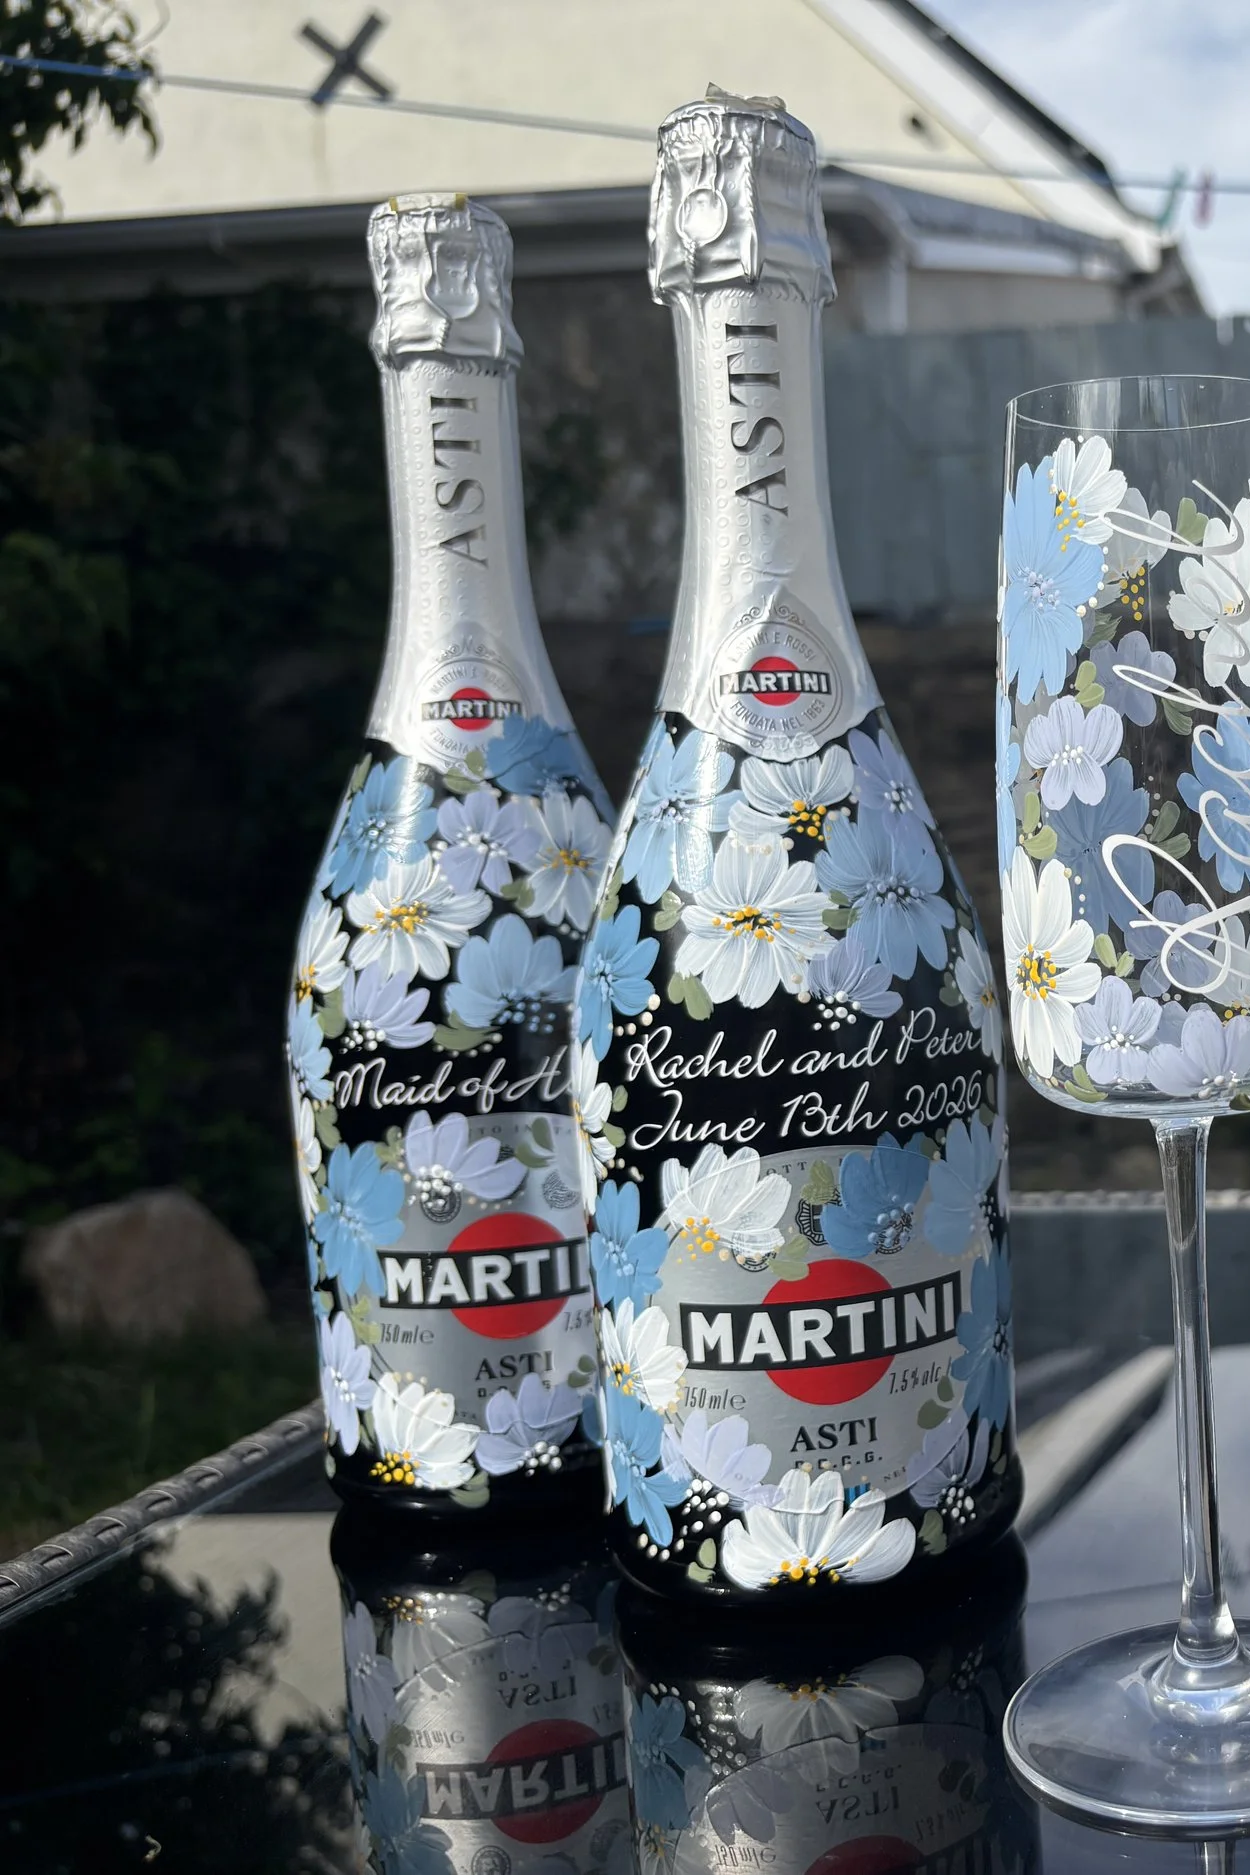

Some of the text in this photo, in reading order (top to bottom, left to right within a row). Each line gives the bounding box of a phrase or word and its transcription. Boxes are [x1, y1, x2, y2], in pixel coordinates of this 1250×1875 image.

[725, 322, 788, 517] ASTI
[430, 395, 488, 569] ASTI
[784, 634, 817, 661] ROSSI
[722, 671, 828, 694] MARTINI
[730, 701, 776, 732] FONDATA
[781, 715, 804, 732] NEL
[625, 1006, 985, 1089] Rachel and Peter
[335, 1057, 456, 1110] Maid
[457, 1058, 508, 1114] of
[629, 1069, 985, 1151] June 13th 2026
[688, 1281, 956, 1365] MARTINI
[475, 1350, 554, 1381] ASTI
[790, 1417, 878, 1453] ASTI
